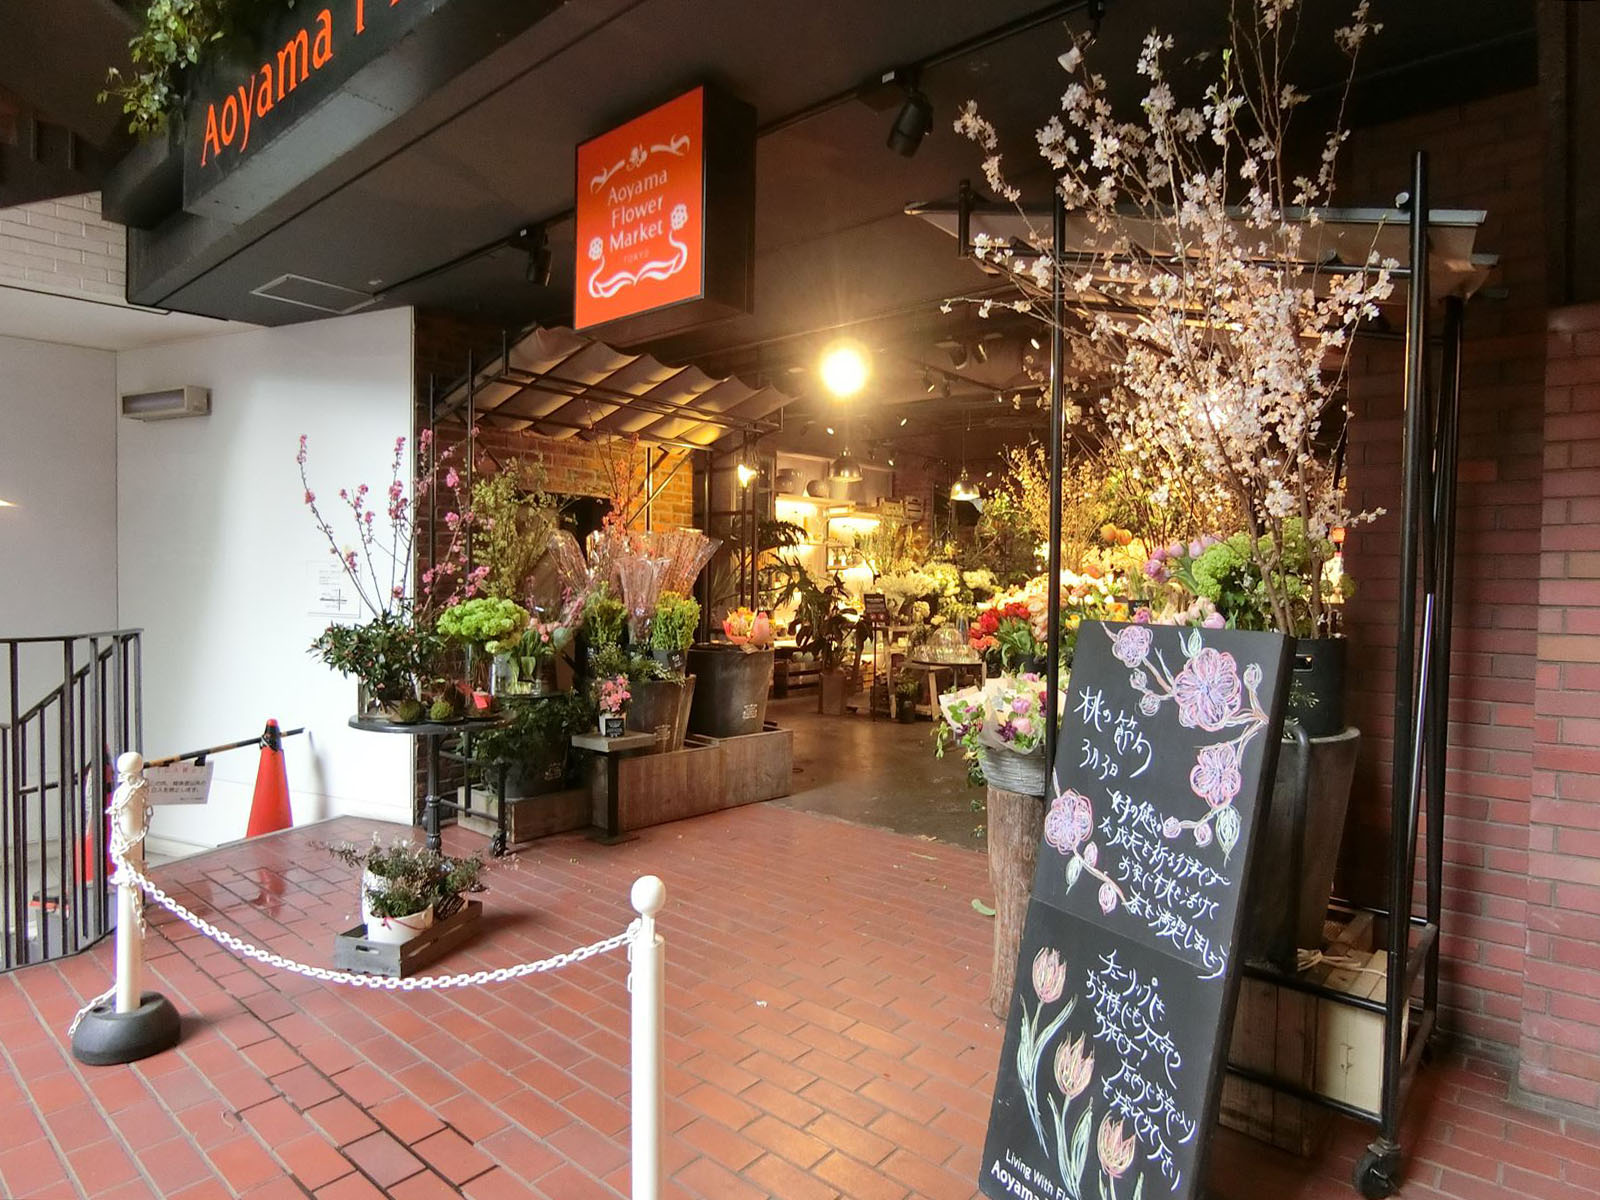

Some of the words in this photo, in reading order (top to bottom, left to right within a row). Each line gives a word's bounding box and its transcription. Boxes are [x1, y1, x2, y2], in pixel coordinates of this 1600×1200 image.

[201, 9, 334, 168] Aoyama
[608, 169, 668, 206] Aoyama
[611, 195, 663, 228] Flower
[609, 219, 664, 252] Market
[1073, 686, 1152, 778] 桃の節句
[1079, 738, 1119, 780] 3月3日
[1005, 1147, 1032, 1181] Living
[1033, 1168, 1054, 1196] With
